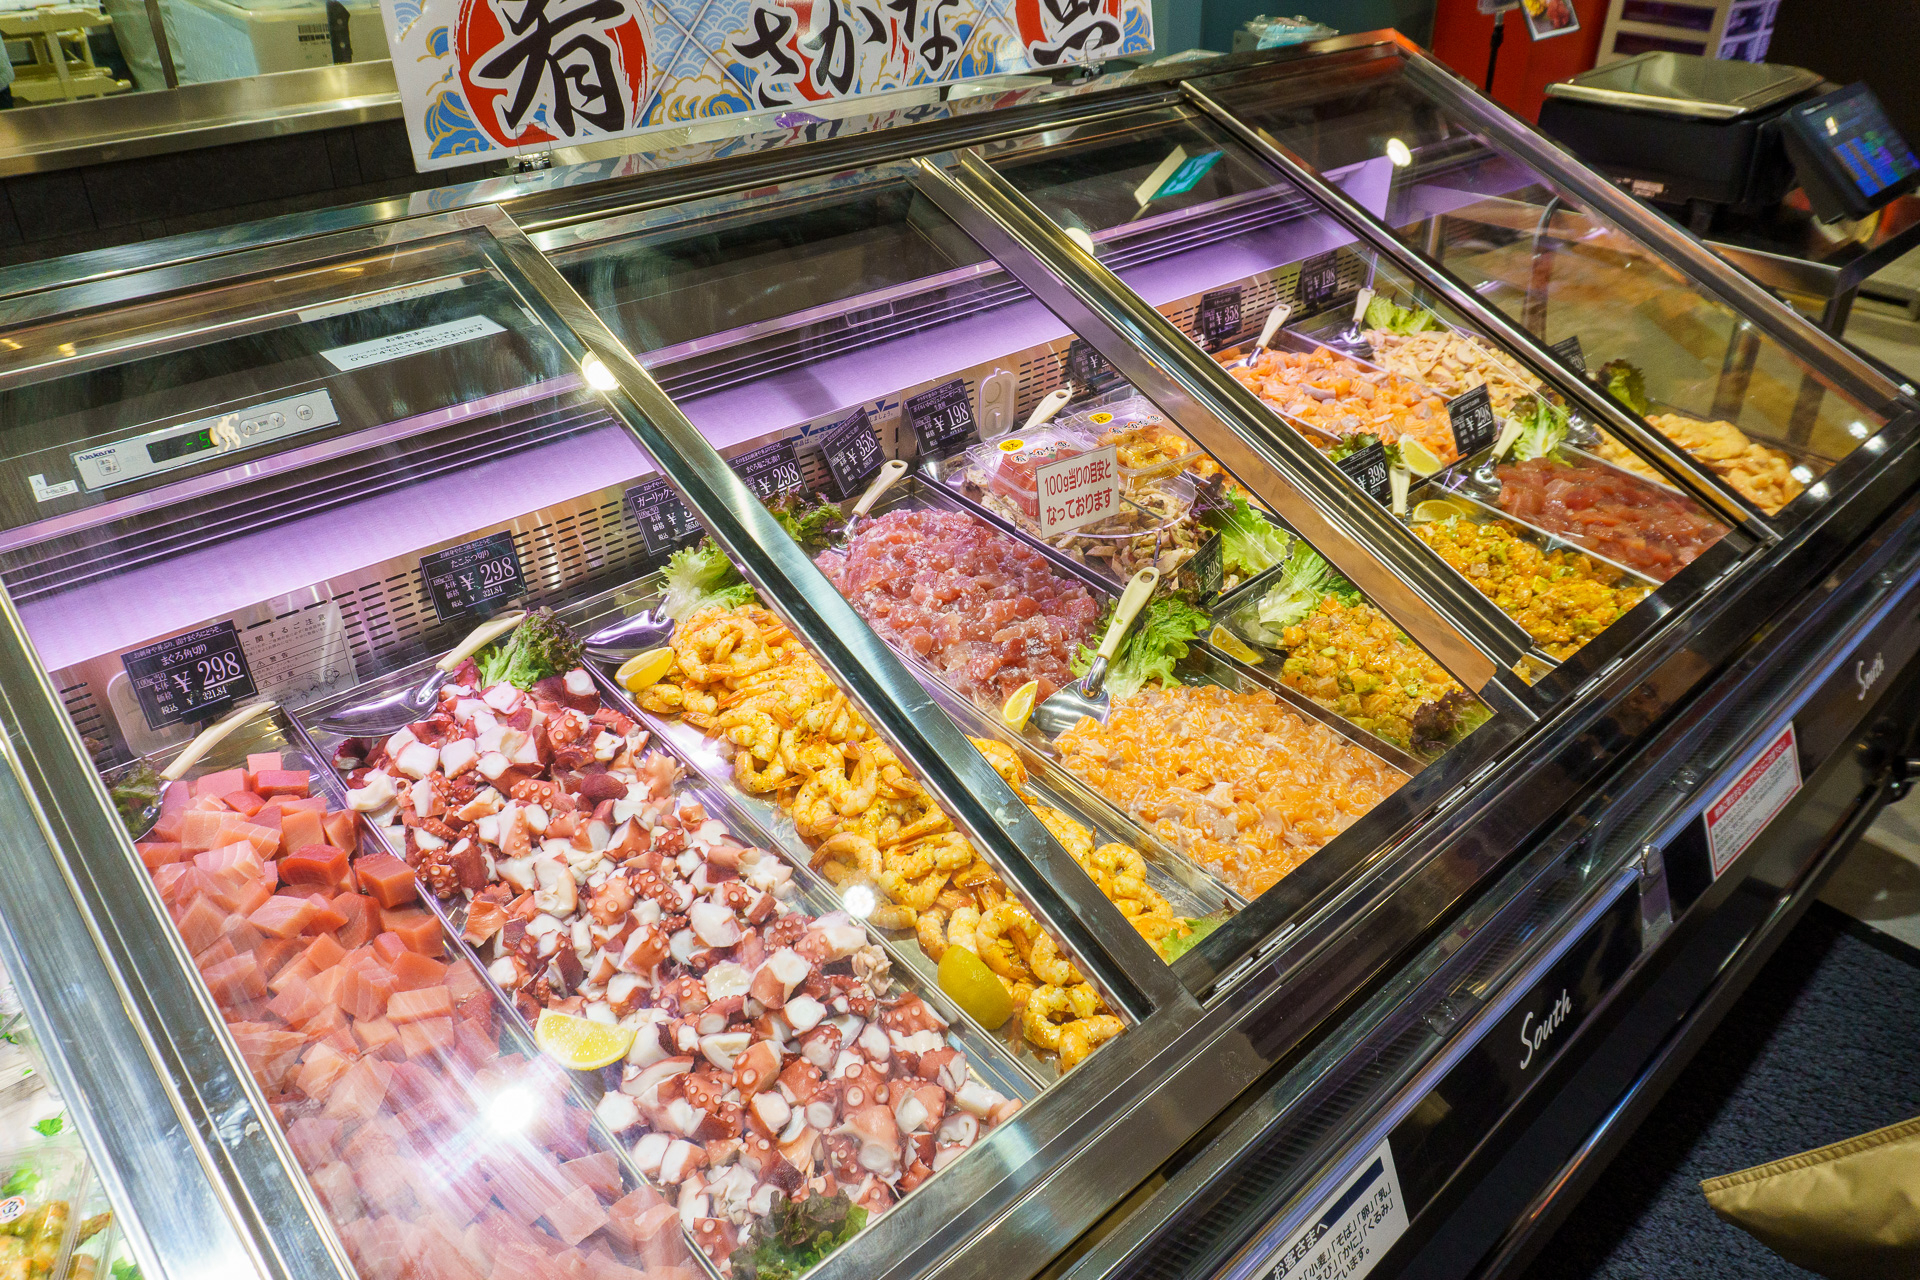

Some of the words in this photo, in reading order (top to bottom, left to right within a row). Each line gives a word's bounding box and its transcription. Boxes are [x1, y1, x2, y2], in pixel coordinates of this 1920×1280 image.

[1224, 304, 1240, 323] 358
[948, 402, 969, 428] 198
[1474, 403, 1492, 428] 298
[78, 447, 116, 462] Nakano
[855, 429, 876, 458] 358
[772, 461, 800, 489] 298
[1044, 458, 1112, 497] 100g当りの目安と
[1367, 461, 1387, 485] 398
[1046, 486, 1113, 527] なっております
[450, 549, 490, 569] たこぶつ切り
[480, 556, 515, 586] 298
[1204, 555, 1220, 583] 398
[133, 626, 224, 660] お刺身や丼ぶり、漬けまぐろにどうぞ。
[160, 643, 208, 667] まぐろ角切り
[153, 680, 170, 692] 本体
[197, 651, 241, 687] 298
[1855, 651, 1885, 701] South
[156, 689, 173, 703] 価格
[160, 702, 179, 716] 税込
[202, 684, 227, 702] 321.84
[1520, 988, 1572, 1070] South
[1297, 1182, 1392, 1280] 「小麦」「そば」「卵」「乳」
[1272, 1222, 1329, 1280] お客さまへ
